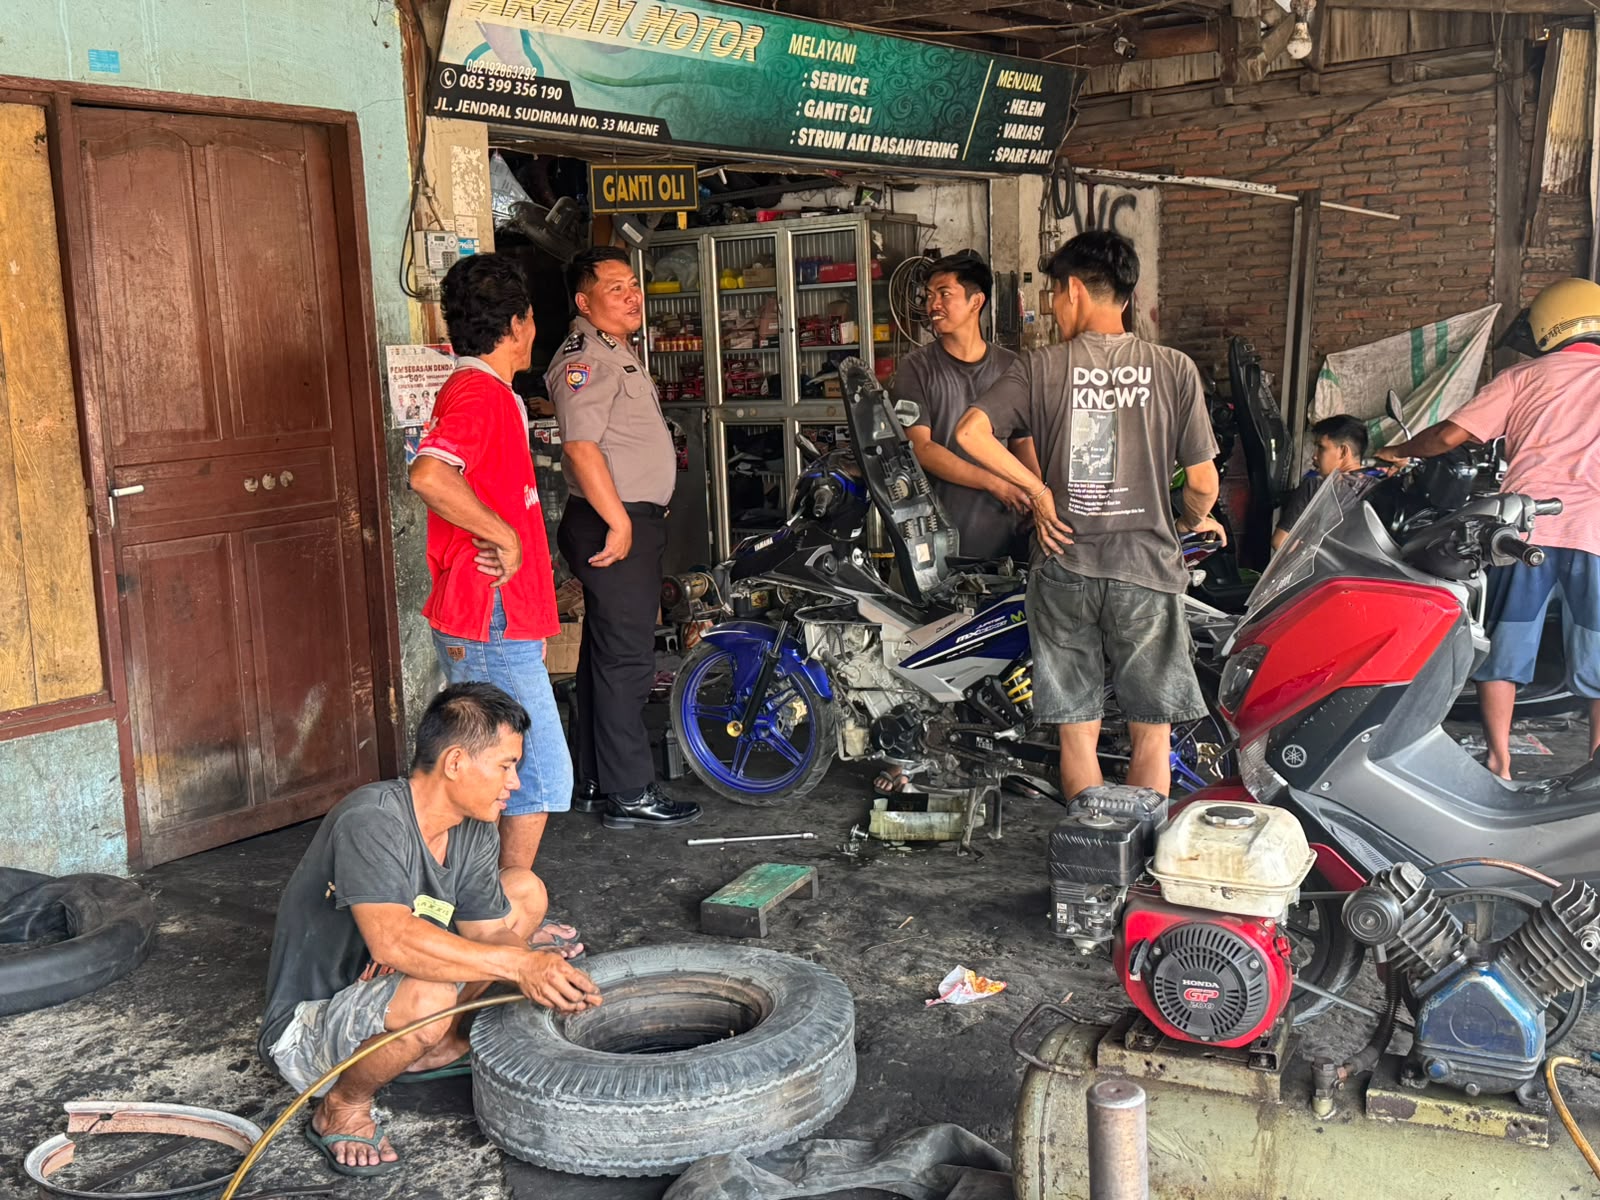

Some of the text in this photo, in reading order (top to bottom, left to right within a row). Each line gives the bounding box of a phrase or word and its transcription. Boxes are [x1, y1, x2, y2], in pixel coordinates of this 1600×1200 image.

[632, 6, 764, 62] MOTOR
[788, 33, 857, 64] MELAYANI
[459, 73, 563, 101] 085 399 356 190
[809, 70, 870, 96] SERVICE
[996, 69, 1043, 92] MENJUAL
[433, 97, 659, 136] JL. JENDRAL SUDIRMAN NO. 33 MAJENE
[803, 100, 848, 121] GANTI
[849, 104, 873, 125] OLI
[1010, 99, 1046, 118] HELEM
[797, 127, 844, 148] STRUM
[846, 133, 871, 151] AKI
[871, 136, 960, 160] BASAH/KERING
[1003, 123, 1045, 142] VARIASI
[995, 149, 1029, 164] SPARE
[1028, 149, 1053, 165] PART
[602, 174, 686, 202] GANTI OLI
[1073, 365, 1152, 386] DO YOU
[1072, 387, 1151, 410] KNOW?
[1183, 979, 1219, 988] HONDA
